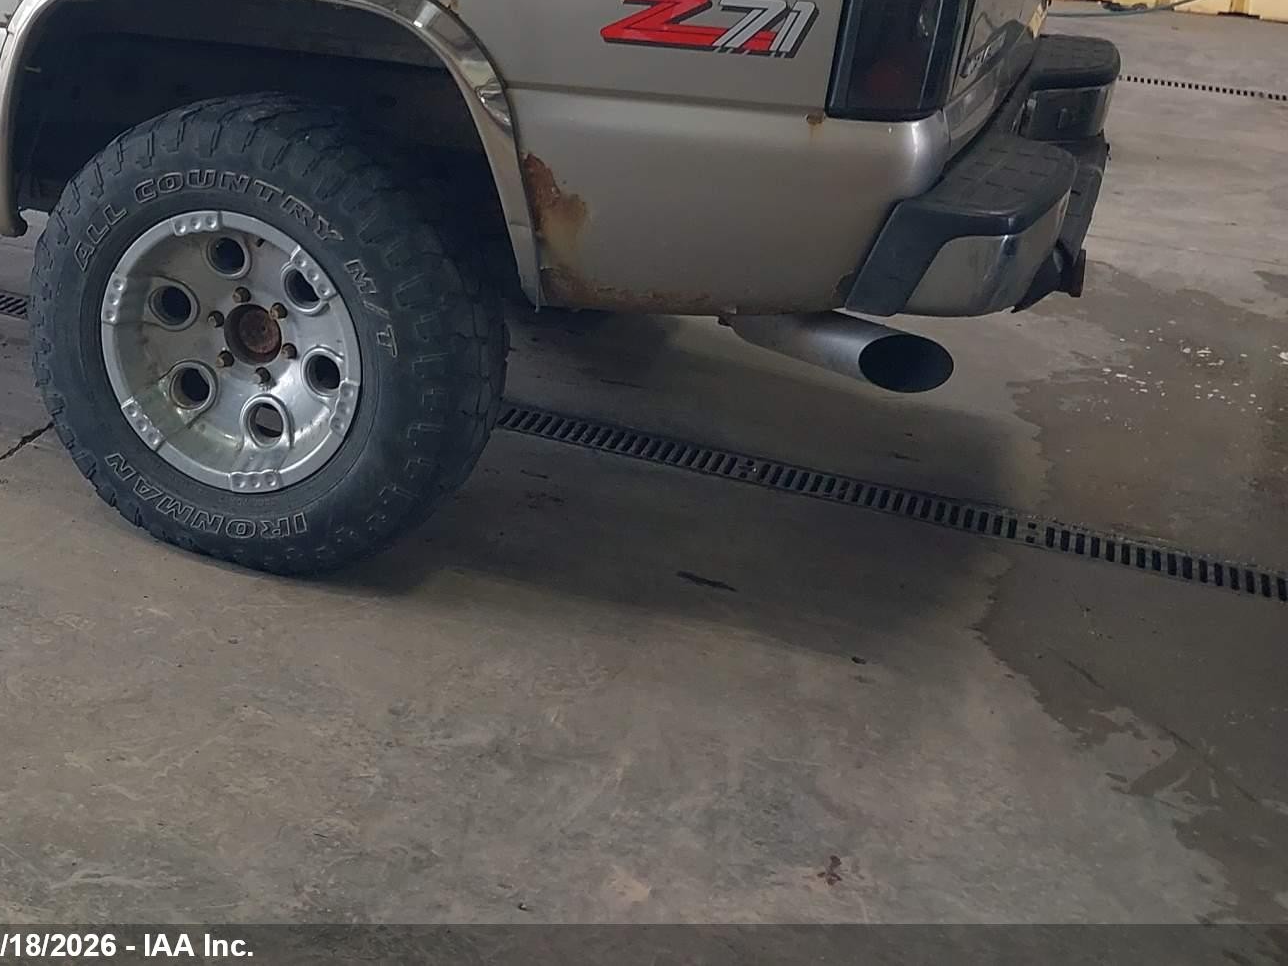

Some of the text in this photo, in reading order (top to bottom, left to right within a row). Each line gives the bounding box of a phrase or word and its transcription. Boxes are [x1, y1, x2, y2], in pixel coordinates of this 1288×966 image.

[74, 168, 399, 359] ALL COUNTRY M/T
[104, 451, 308, 539] IRONMAN
